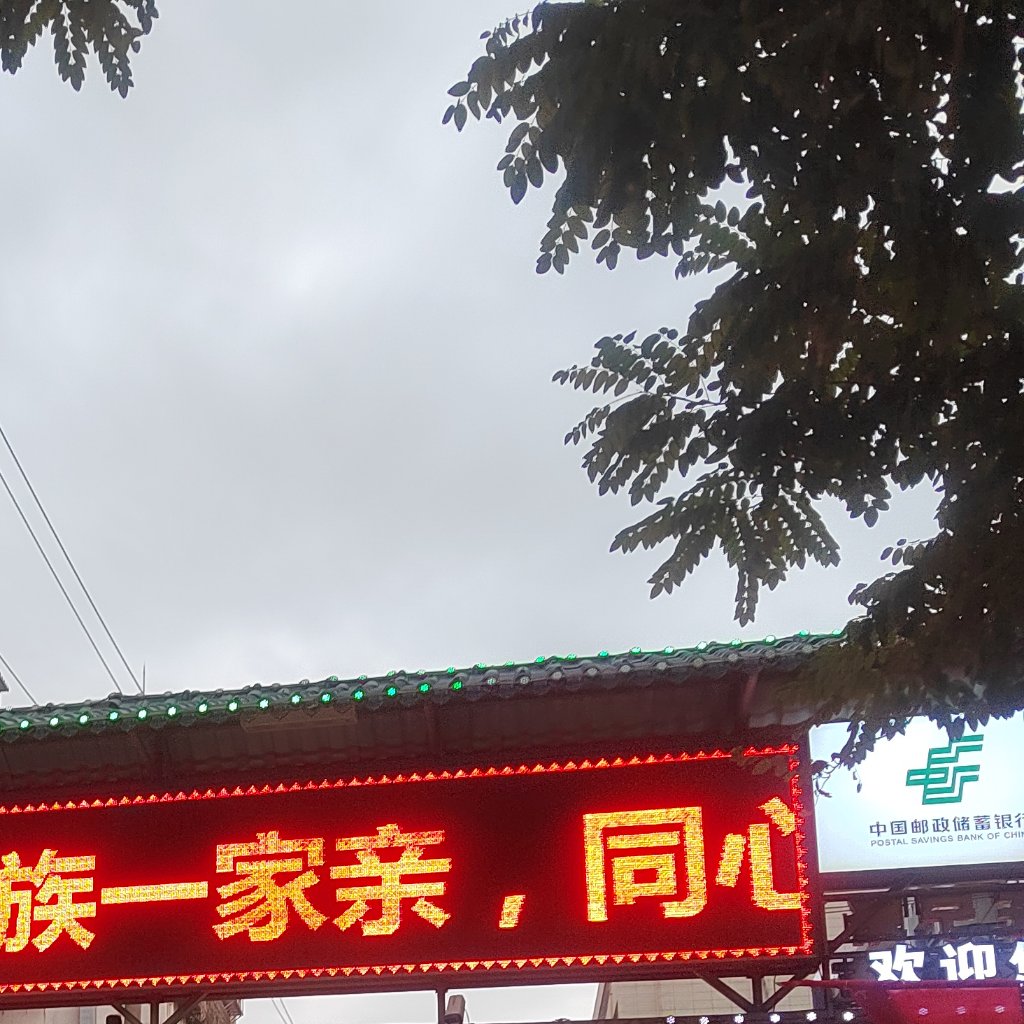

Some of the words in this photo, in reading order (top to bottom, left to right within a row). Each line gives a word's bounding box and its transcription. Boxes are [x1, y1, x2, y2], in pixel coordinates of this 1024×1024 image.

[871, 838, 908, 847] POSTAL
[911, 835, 954, 845] SAVINGS
[957, 833, 984, 842] BANK
[987, 831, 1001, 840] OF
[869, 941, 1024, 982] 欢迎
